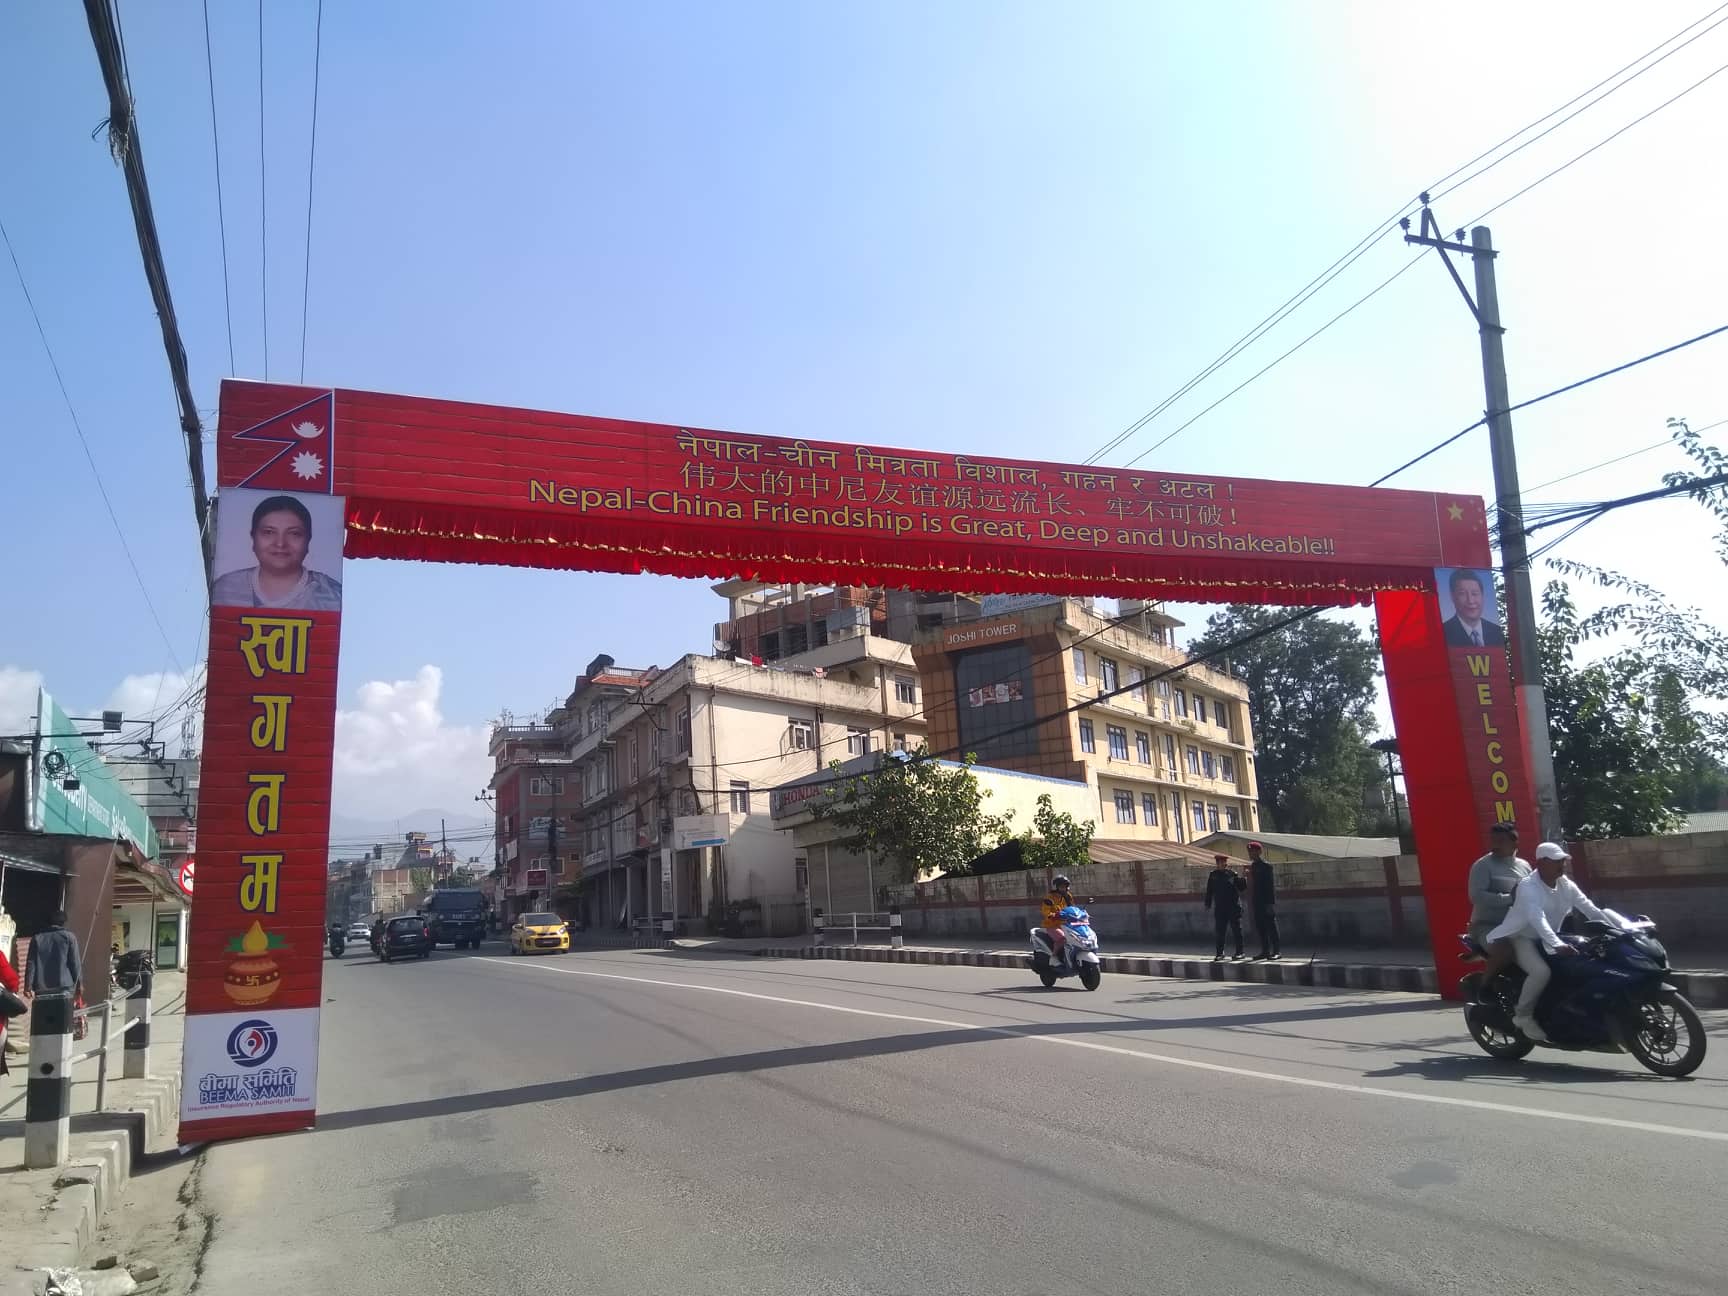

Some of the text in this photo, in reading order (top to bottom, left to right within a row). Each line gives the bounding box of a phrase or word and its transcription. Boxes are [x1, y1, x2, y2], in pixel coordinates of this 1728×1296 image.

[675, 429, 840, 470] नेपाल-चीन
[855, 447, 941, 479] मित्रता
[955, 456, 1048, 491] विशाल,
[1060, 471, 1118, 492] गहन
[1130, 477, 1145, 494] र
[1159, 479, 1216, 500] अटल
[529, 479, 1335, 556] Nepal-China Friendship is Great, Deep and Unshakeable!!
[947, 623, 1017, 645] JOSHI TOWER
[199, 1066, 297, 1092] बीमा समिति
[200, 1084, 296, 1104] BEEMA SAMITI
